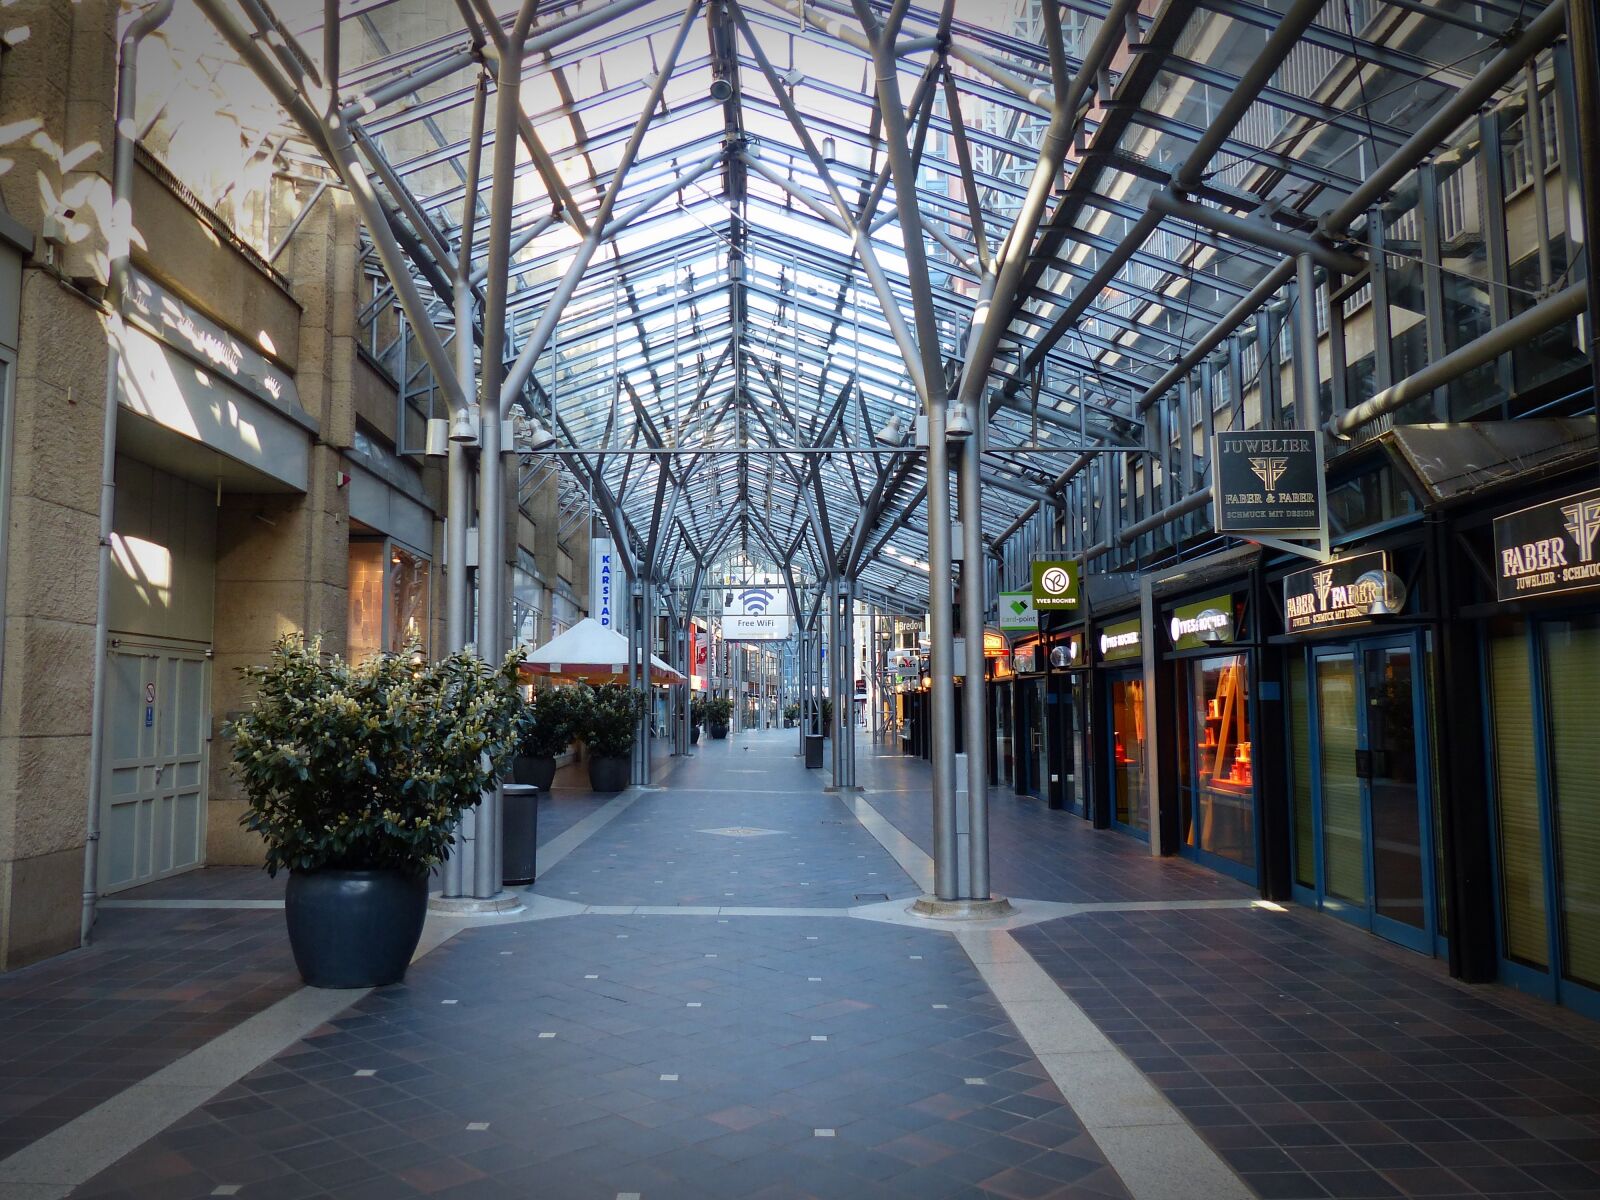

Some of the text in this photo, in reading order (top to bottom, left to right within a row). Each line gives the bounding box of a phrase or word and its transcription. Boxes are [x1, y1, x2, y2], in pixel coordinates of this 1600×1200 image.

[1223, 439, 1312, 453] JUWELIER
[1225, 492, 1315, 504] FABER & FABER
[1226, 509, 1315, 519] SCHMUCK MIT DESIGN
[1501, 537, 1567, 577] FABER
[1516, 571, 1556, 590] JUWELIER
[1286, 593, 1316, 618] FABER
[737, 619, 774, 627] Free WiFi
[1001, 615, 1036, 623] card-point
[1180, 619, 1196, 634] YVES
